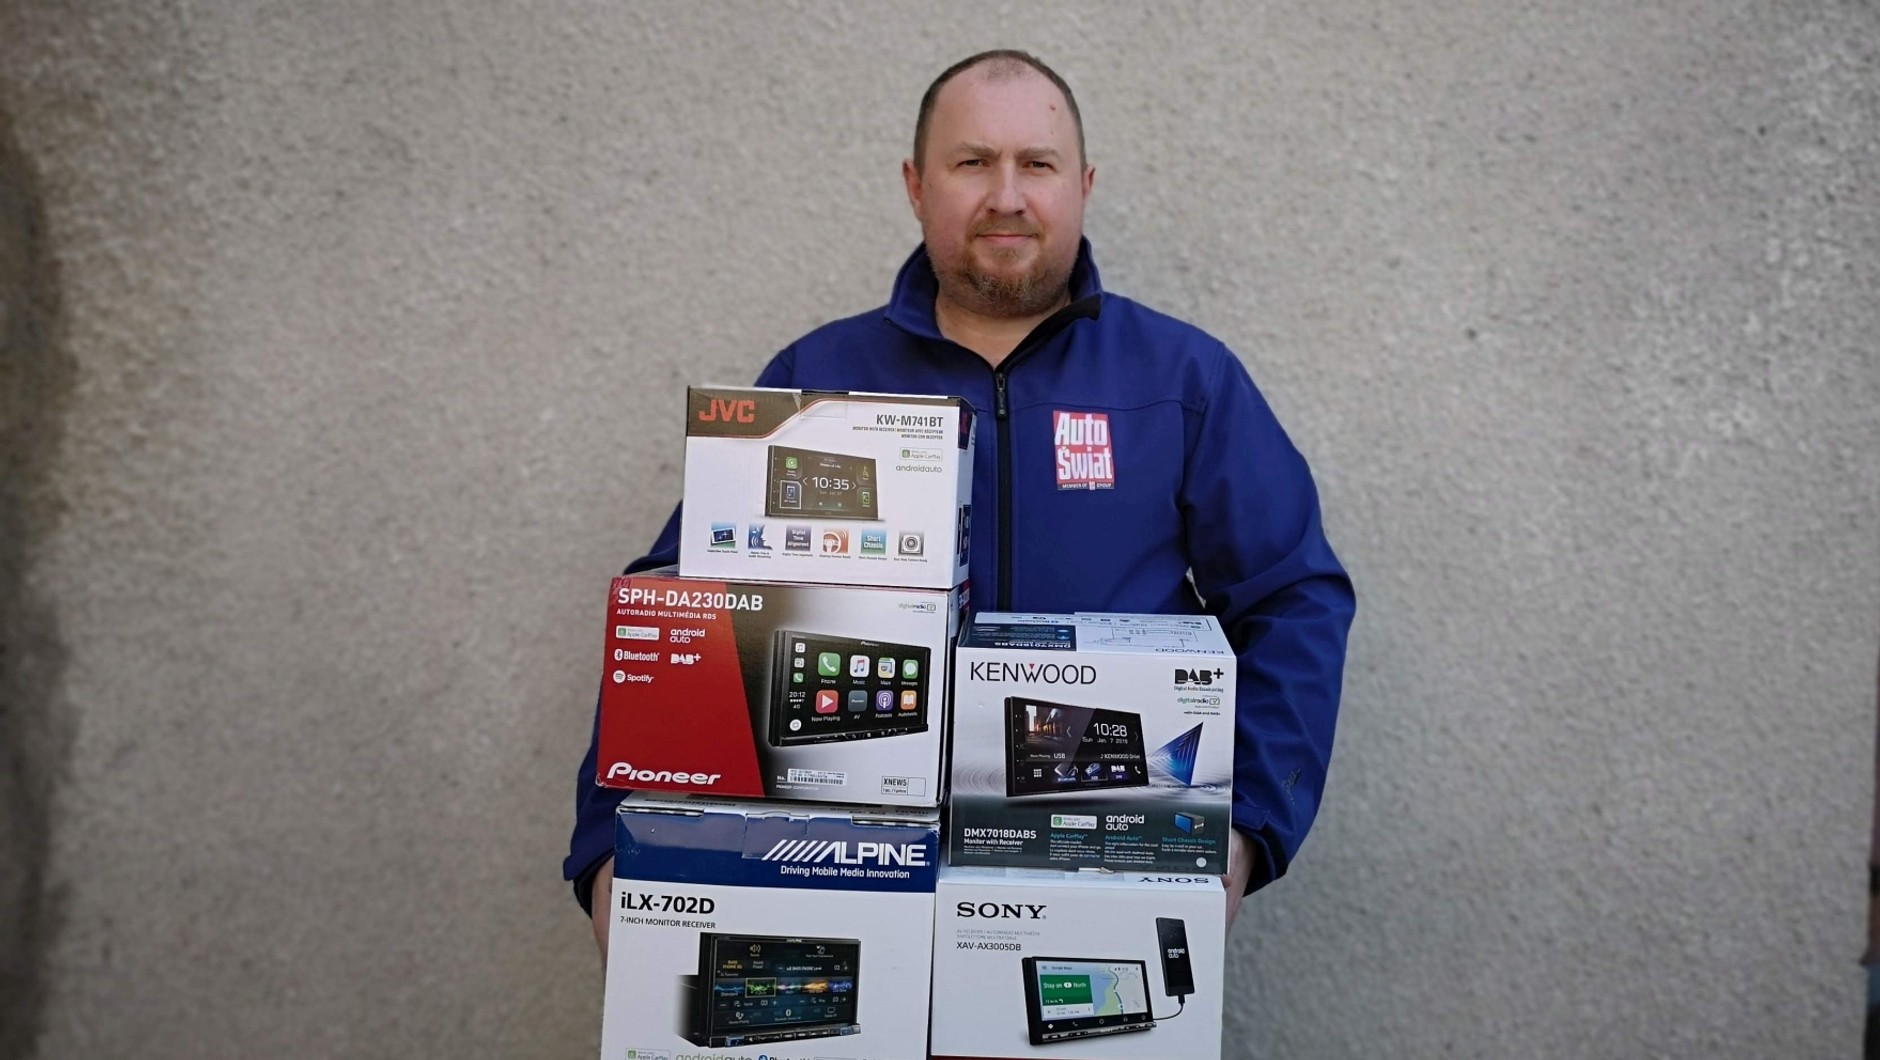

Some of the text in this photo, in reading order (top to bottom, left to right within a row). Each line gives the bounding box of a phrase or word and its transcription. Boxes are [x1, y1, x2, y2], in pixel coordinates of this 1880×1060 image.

[699, 399, 755, 423] JVC
[876, 414, 944, 427] KW-M741BT
[1054, 412, 1108, 446] Auto
[895, 464, 943, 473] androidauto
[812, 476, 850, 491] 10:35
[618, 588, 764, 611] SPH-DA230DAB
[616, 608, 656, 617] AUTORADIO
[657, 609, 701, 619] MULTIMÉDIA
[670, 628, 706, 637] android
[669, 636, 691, 644] auto
[623, 651, 659, 662] Bluetooth
[670, 653, 701, 665] DAB+
[627, 673, 653, 683] Spotify
[970, 661, 1097, 685] KENWOOD
[1174, 667, 1225, 686] DAB+
[1093, 722, 1128, 737] 10:28
[606, 761, 721, 785] Pioneer
[883, 777, 908, 787] XNEWS
[1105, 814, 1145, 824] android
[1105, 823, 1129, 831] auto
[963, 828, 1037, 839] DMX7018DABS
[808, 840, 928, 867] ALPINE
[780, 865, 910, 879] Driving Mobile Media Innovation
[1138, 876, 1209, 884] SONY
[620, 891, 716, 914] iLX-702D
[956, 901, 1048, 920] SONY
[619, 915, 716, 929] 7-INCH MONITOR RECEIVER
[956, 941, 1022, 951] XAV-AX3005DB
[1043, 982, 1055, 990] Stay
